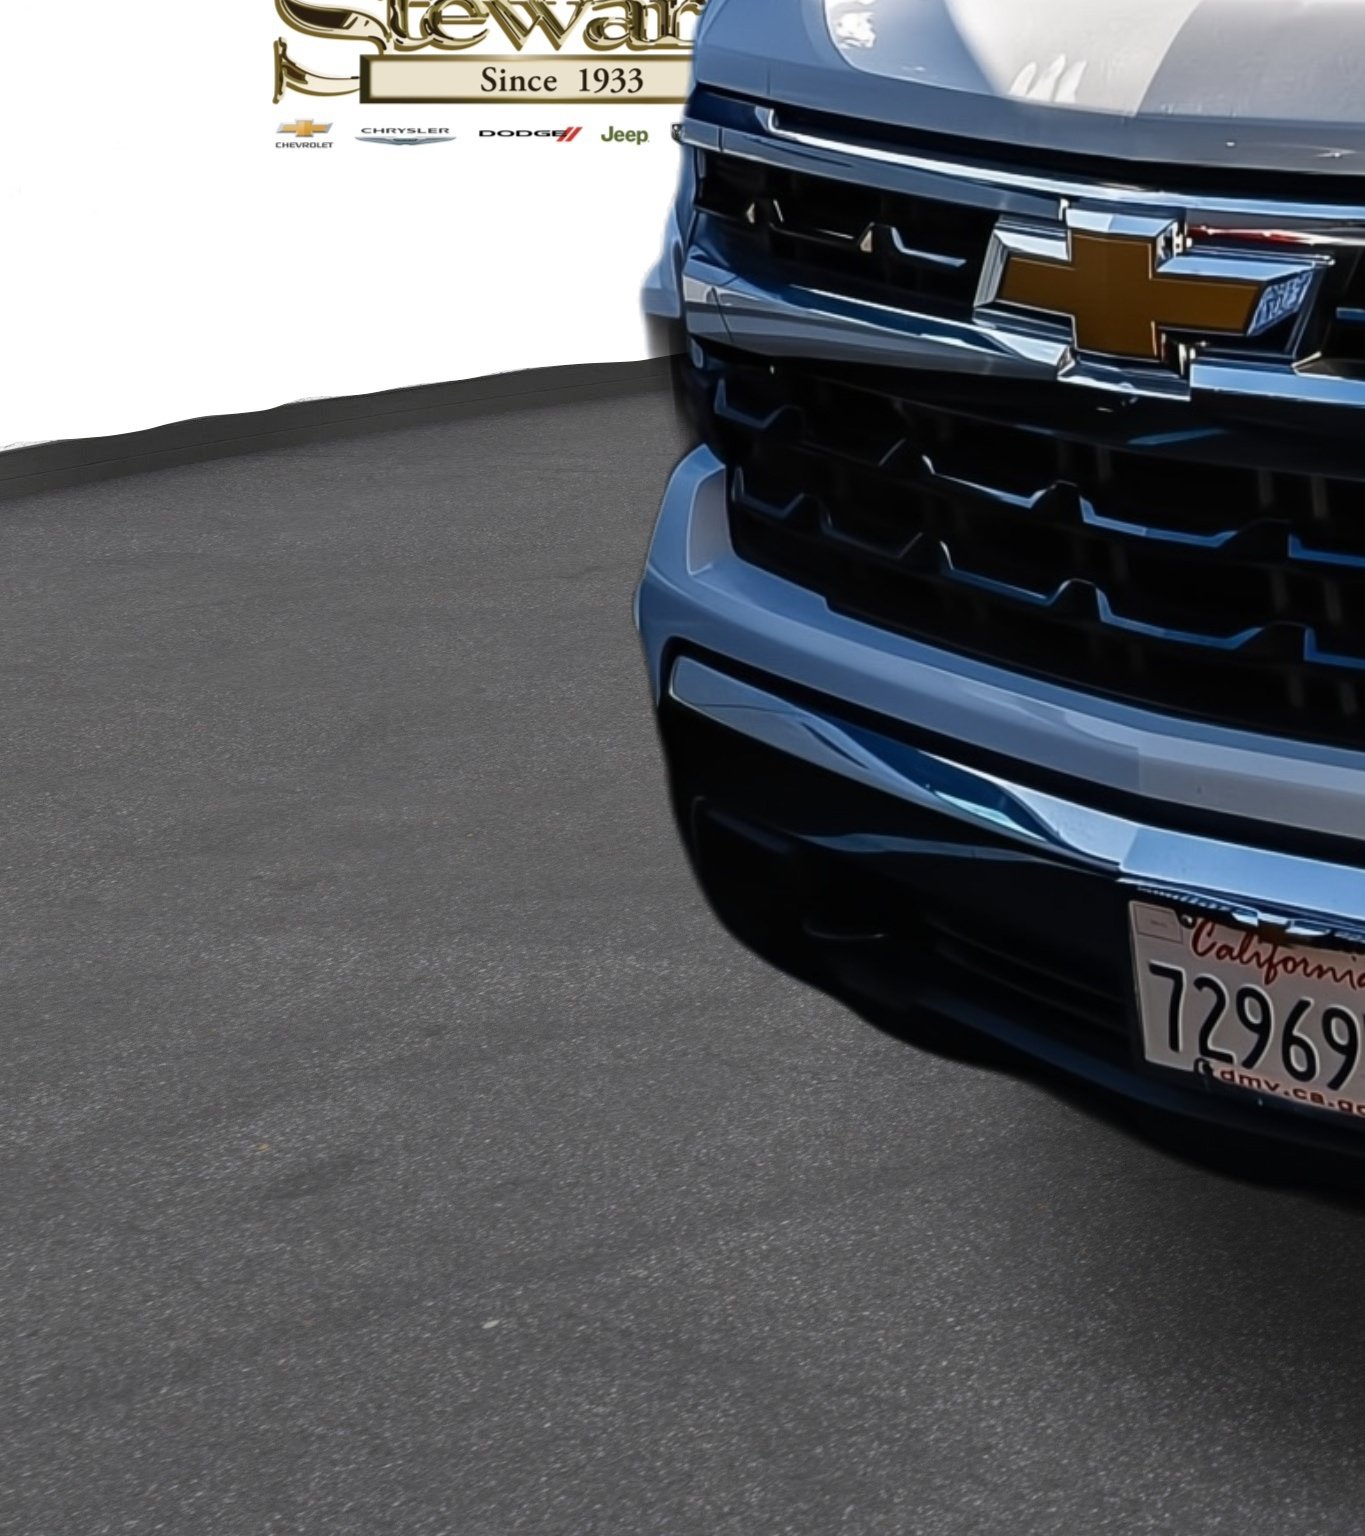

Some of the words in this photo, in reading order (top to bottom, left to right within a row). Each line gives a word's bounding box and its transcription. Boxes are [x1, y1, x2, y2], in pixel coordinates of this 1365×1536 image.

[480, 66, 557, 92] Since
[578, 67, 644, 93] 1933
[274, 141, 334, 149] CHEVROLET
[360, 127, 450, 135] CHRYSLER
[478, 129, 567, 138] DODGE
[600, 125, 648, 145] Jeep
